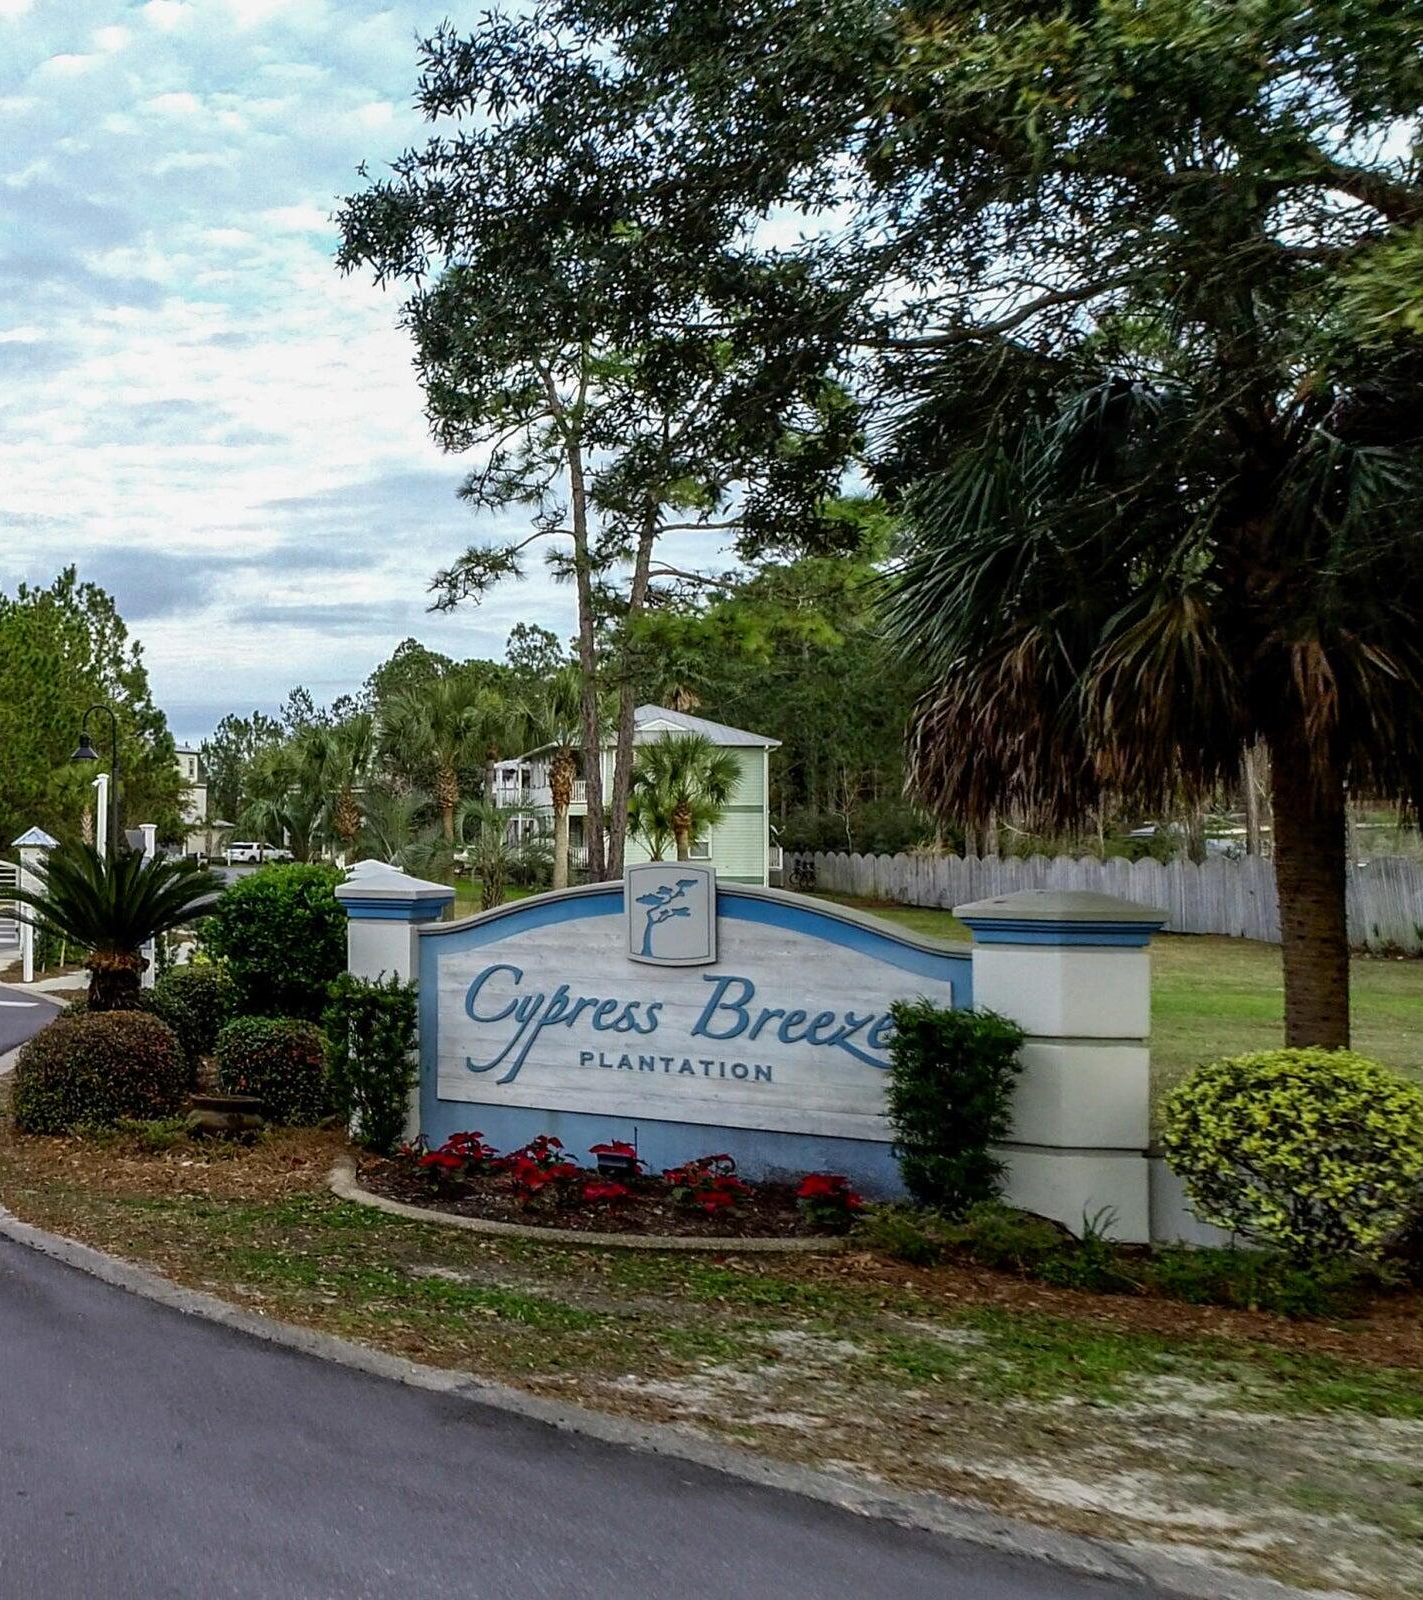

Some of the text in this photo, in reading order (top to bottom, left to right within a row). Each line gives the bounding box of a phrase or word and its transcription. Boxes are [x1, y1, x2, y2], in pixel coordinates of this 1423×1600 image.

[465, 964, 894, 1085] Cypress Breeze
[579, 1050, 773, 1082] PLANTATION
